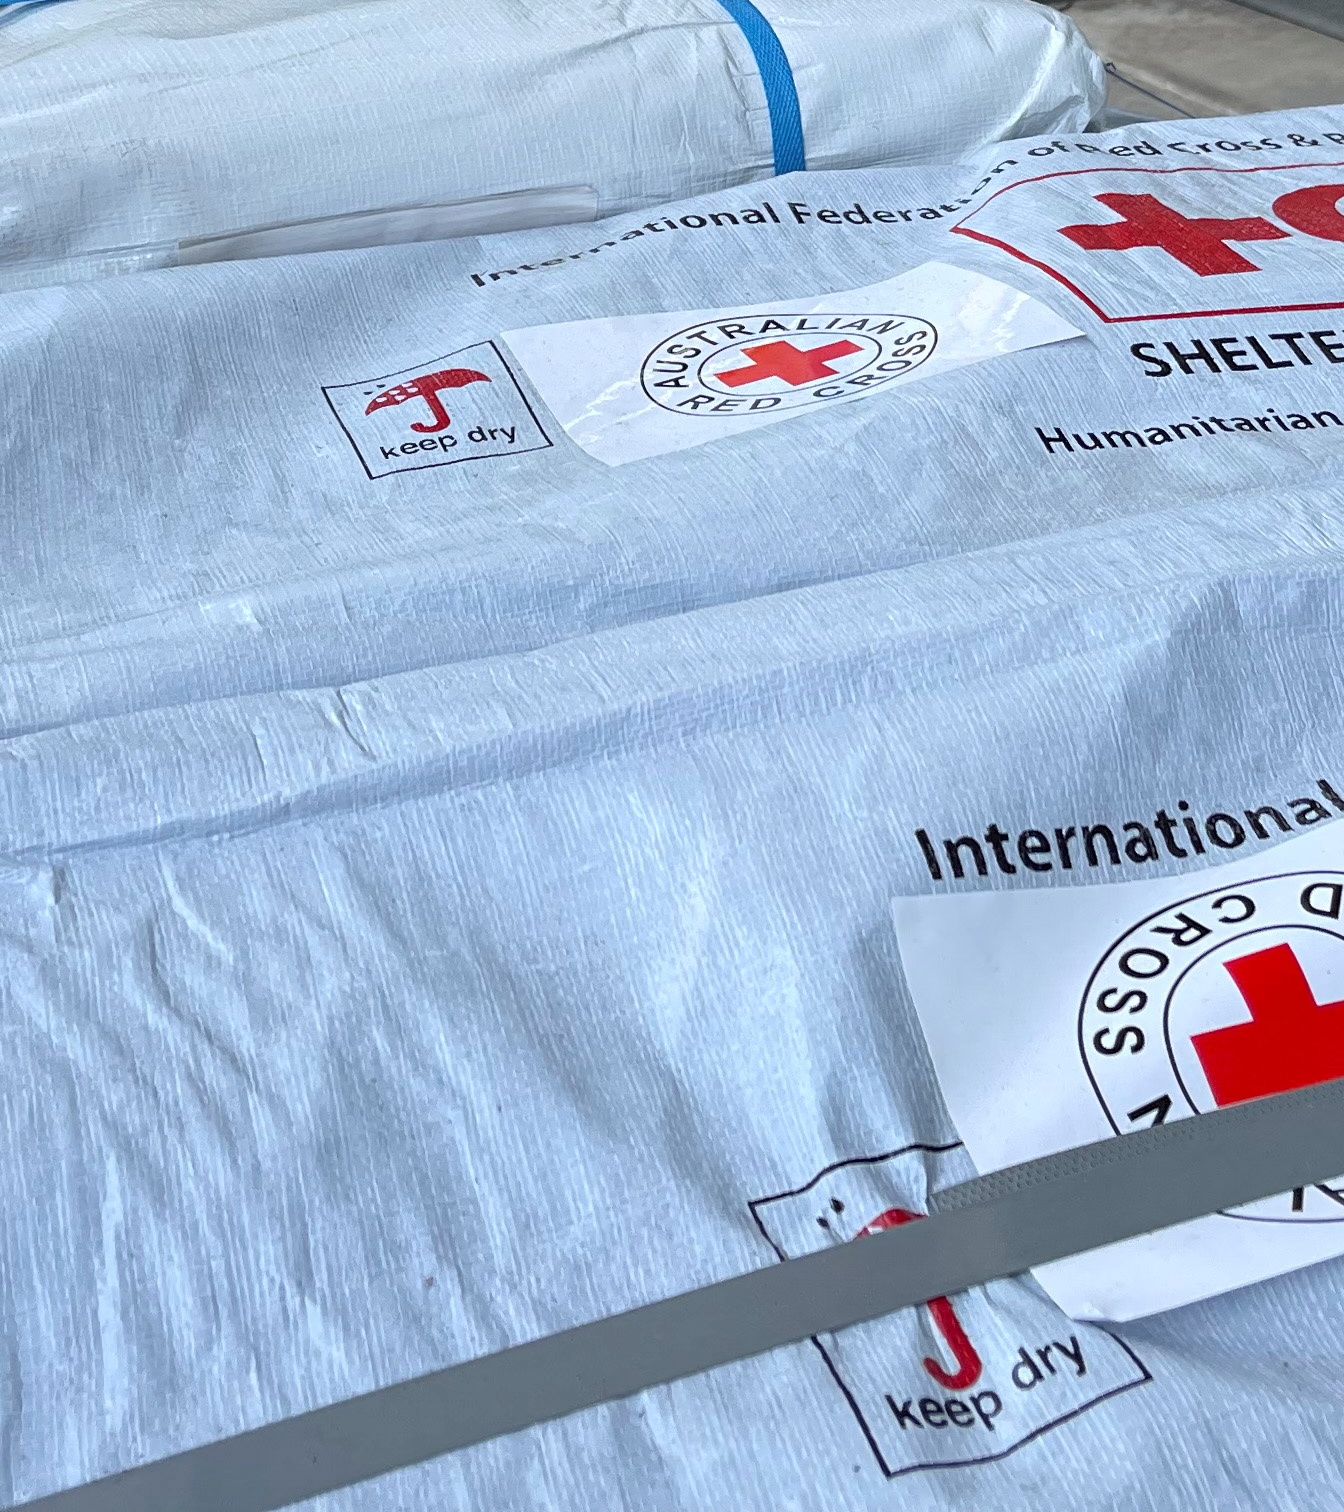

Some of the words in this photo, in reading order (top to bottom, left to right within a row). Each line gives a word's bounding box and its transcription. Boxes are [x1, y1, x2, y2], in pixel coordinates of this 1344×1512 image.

[470, 202, 781, 288] International
[788, 159, 1019, 226] Federation
[1027, 141, 1069, 157] of
[1287, 133, 1319, 148] &
[659, 314, 904, 390] AUSTRALIAN
[678, 390, 785, 415] RED
[811, 329, 930, 401] CROSS
[378, 431, 459, 461] keep
[467, 420, 517, 448] dry
[1034, 400, 1343, 455] Humanitarian
[1093, 894, 1256, 1055] CROSS
[885, 1387, 1002, 1434] keep
[1011, 1332, 1090, 1394] dry
